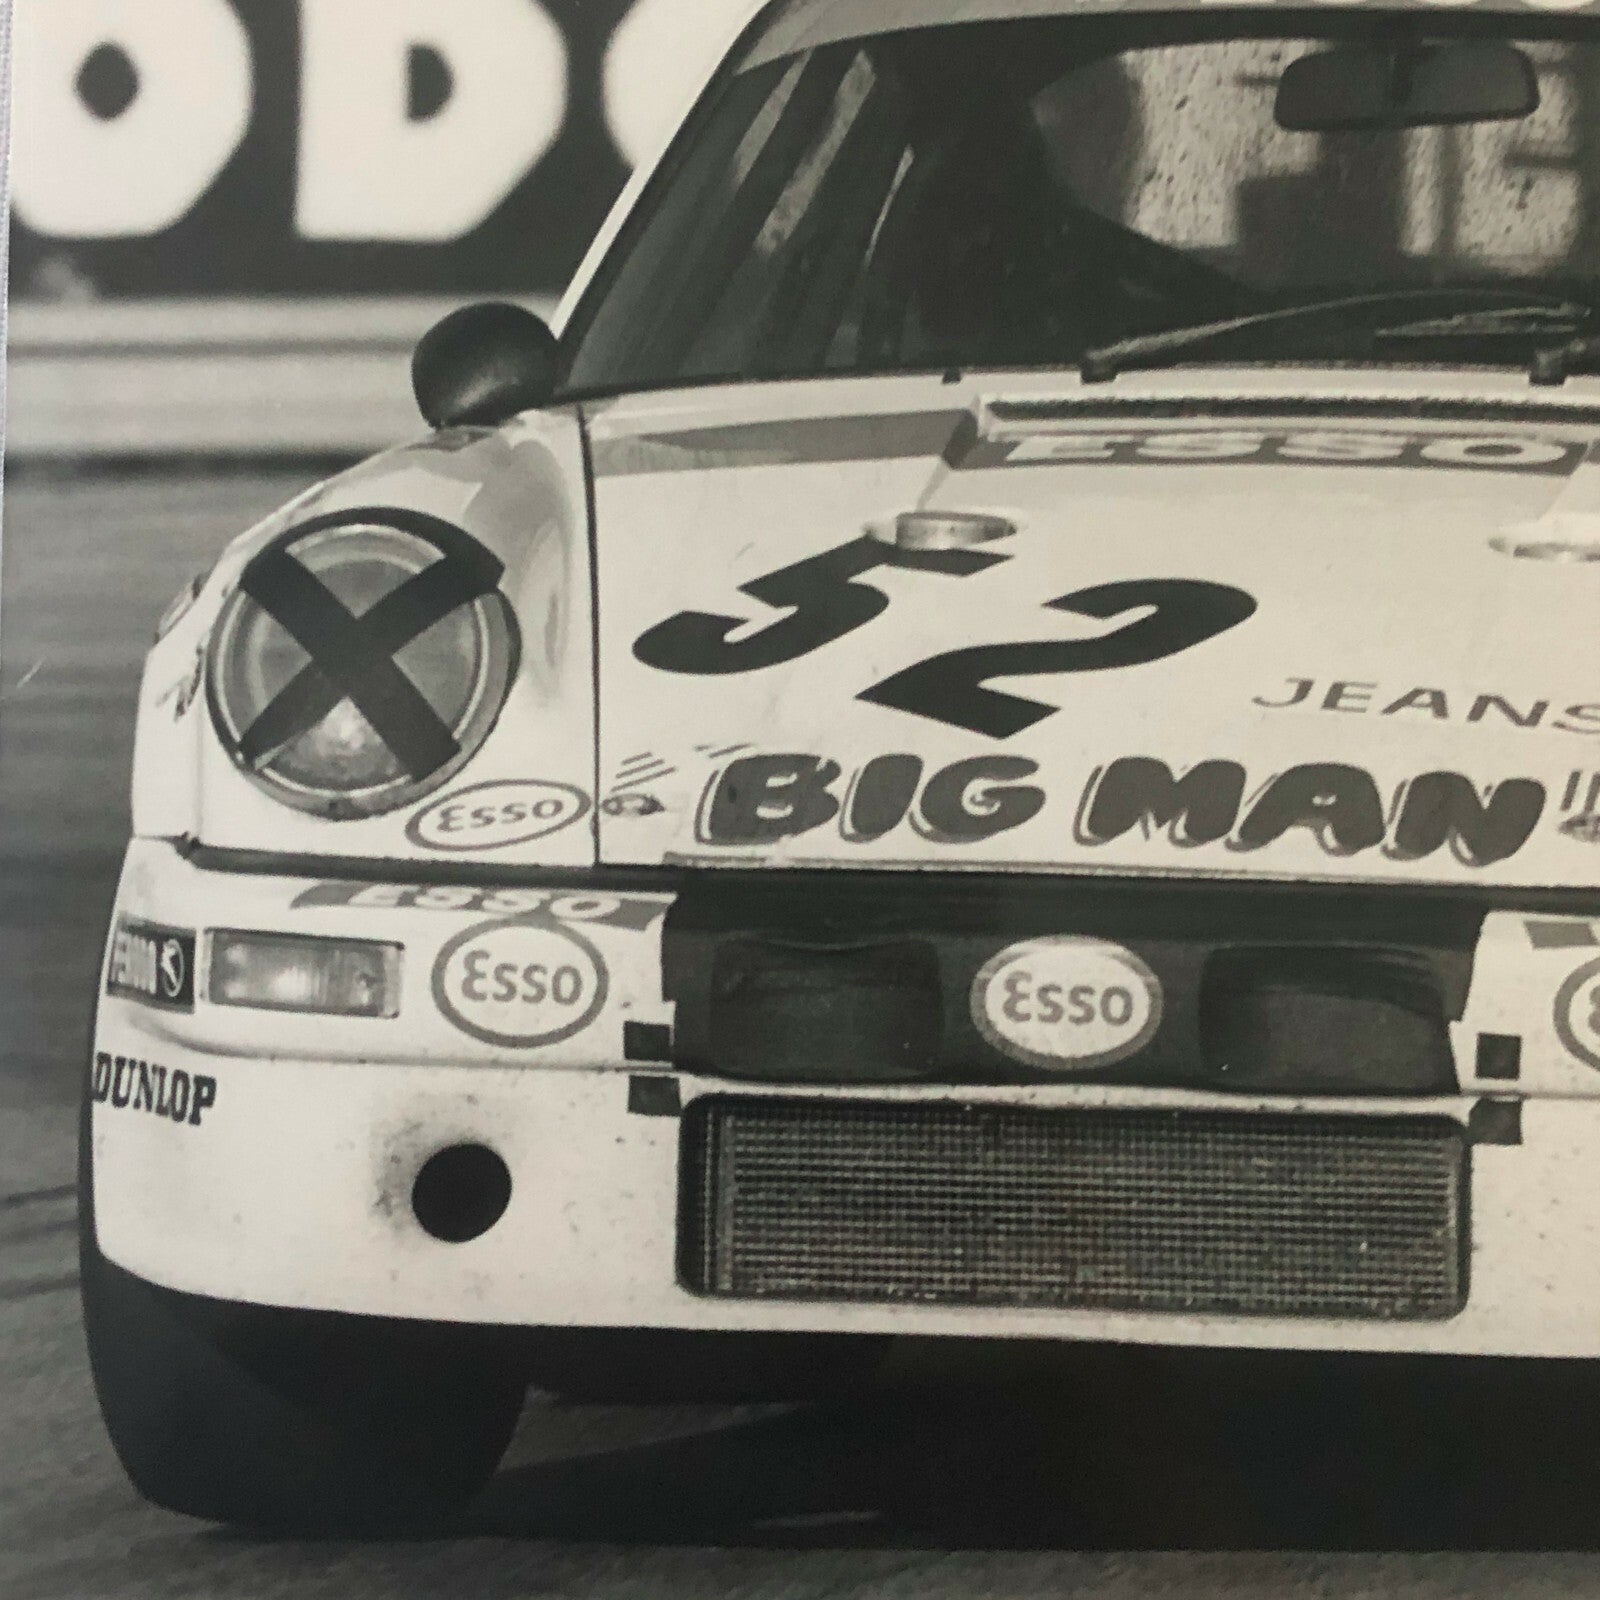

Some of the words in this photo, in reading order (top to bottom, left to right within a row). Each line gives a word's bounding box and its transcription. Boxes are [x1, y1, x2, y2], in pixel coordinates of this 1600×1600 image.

[694, 753, 1046, 846] BIG
[1073, 756, 1547, 868] MAN
[93, 1052, 216, 1125] DUNLOP
